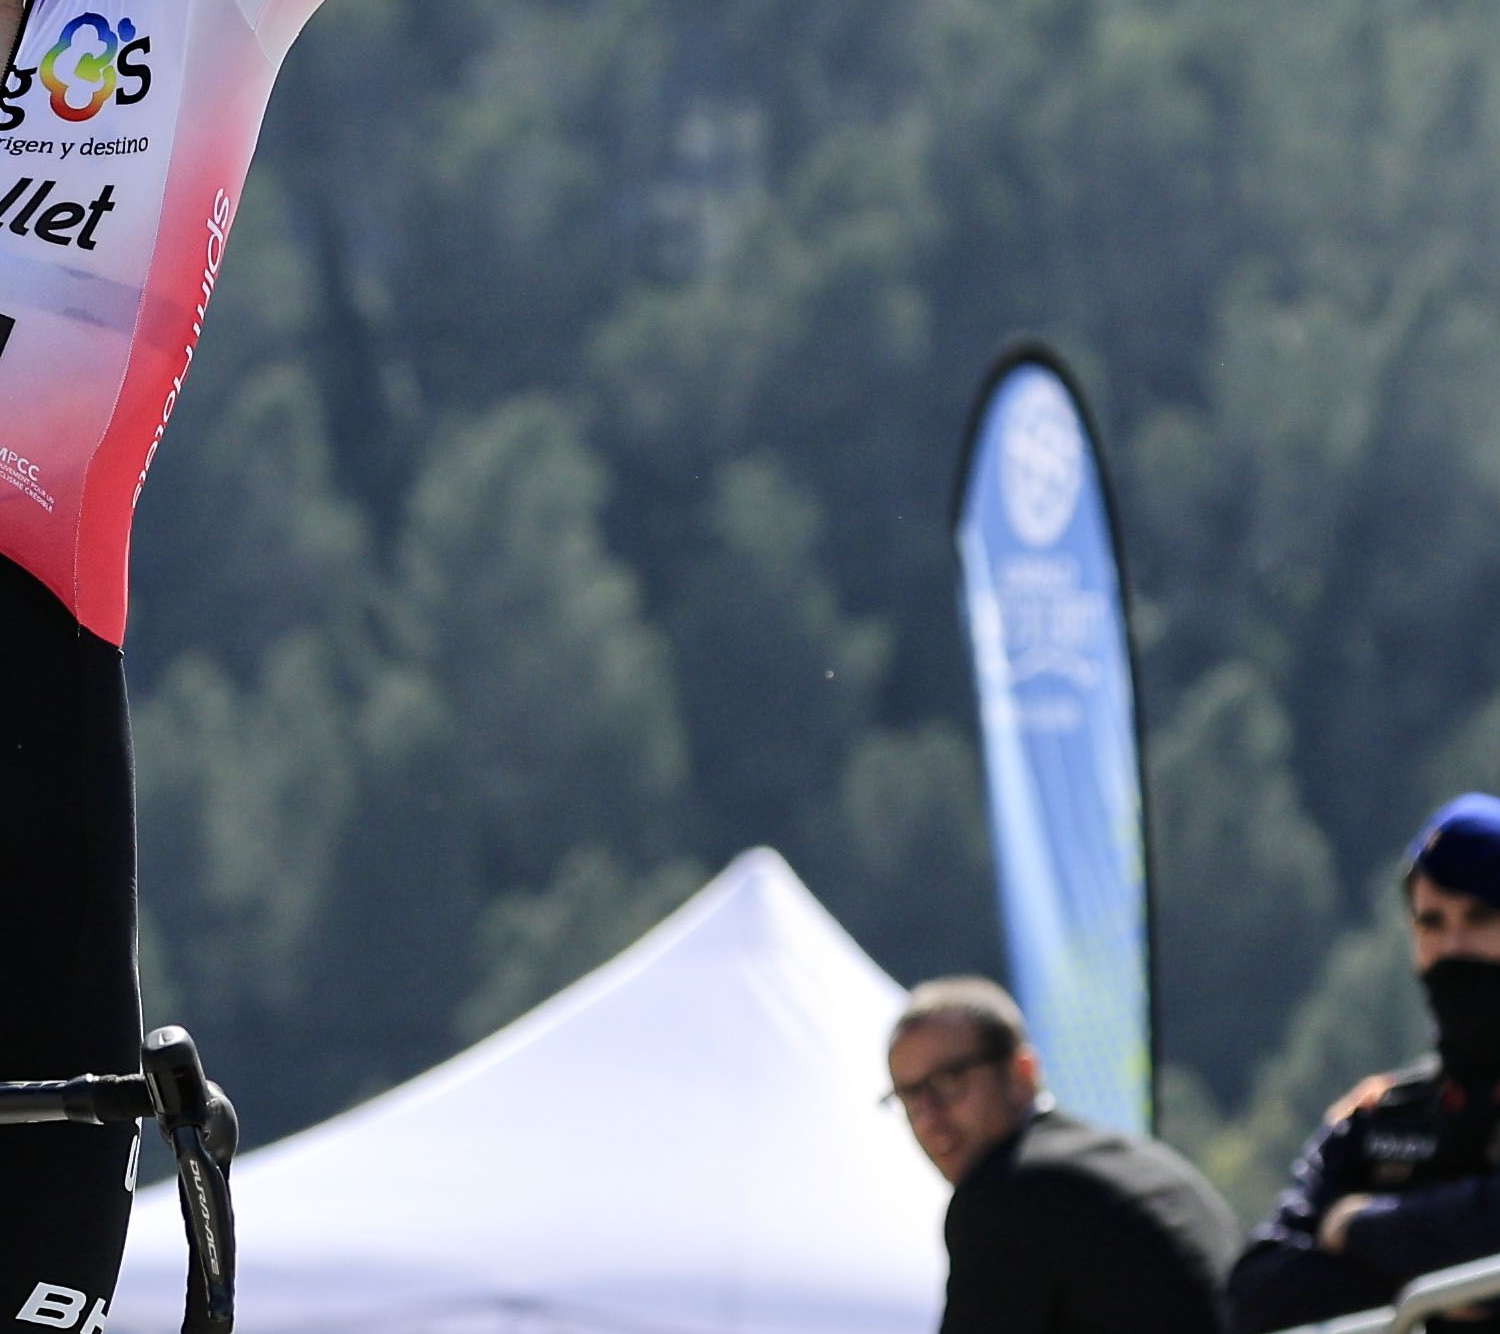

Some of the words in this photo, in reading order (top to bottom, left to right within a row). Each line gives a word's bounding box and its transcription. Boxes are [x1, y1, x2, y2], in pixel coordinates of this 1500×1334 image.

[59, 140, 75, 160] y
[79, 134, 149, 158] destino
[189, 1158, 220, 1277] DURA-ACE
